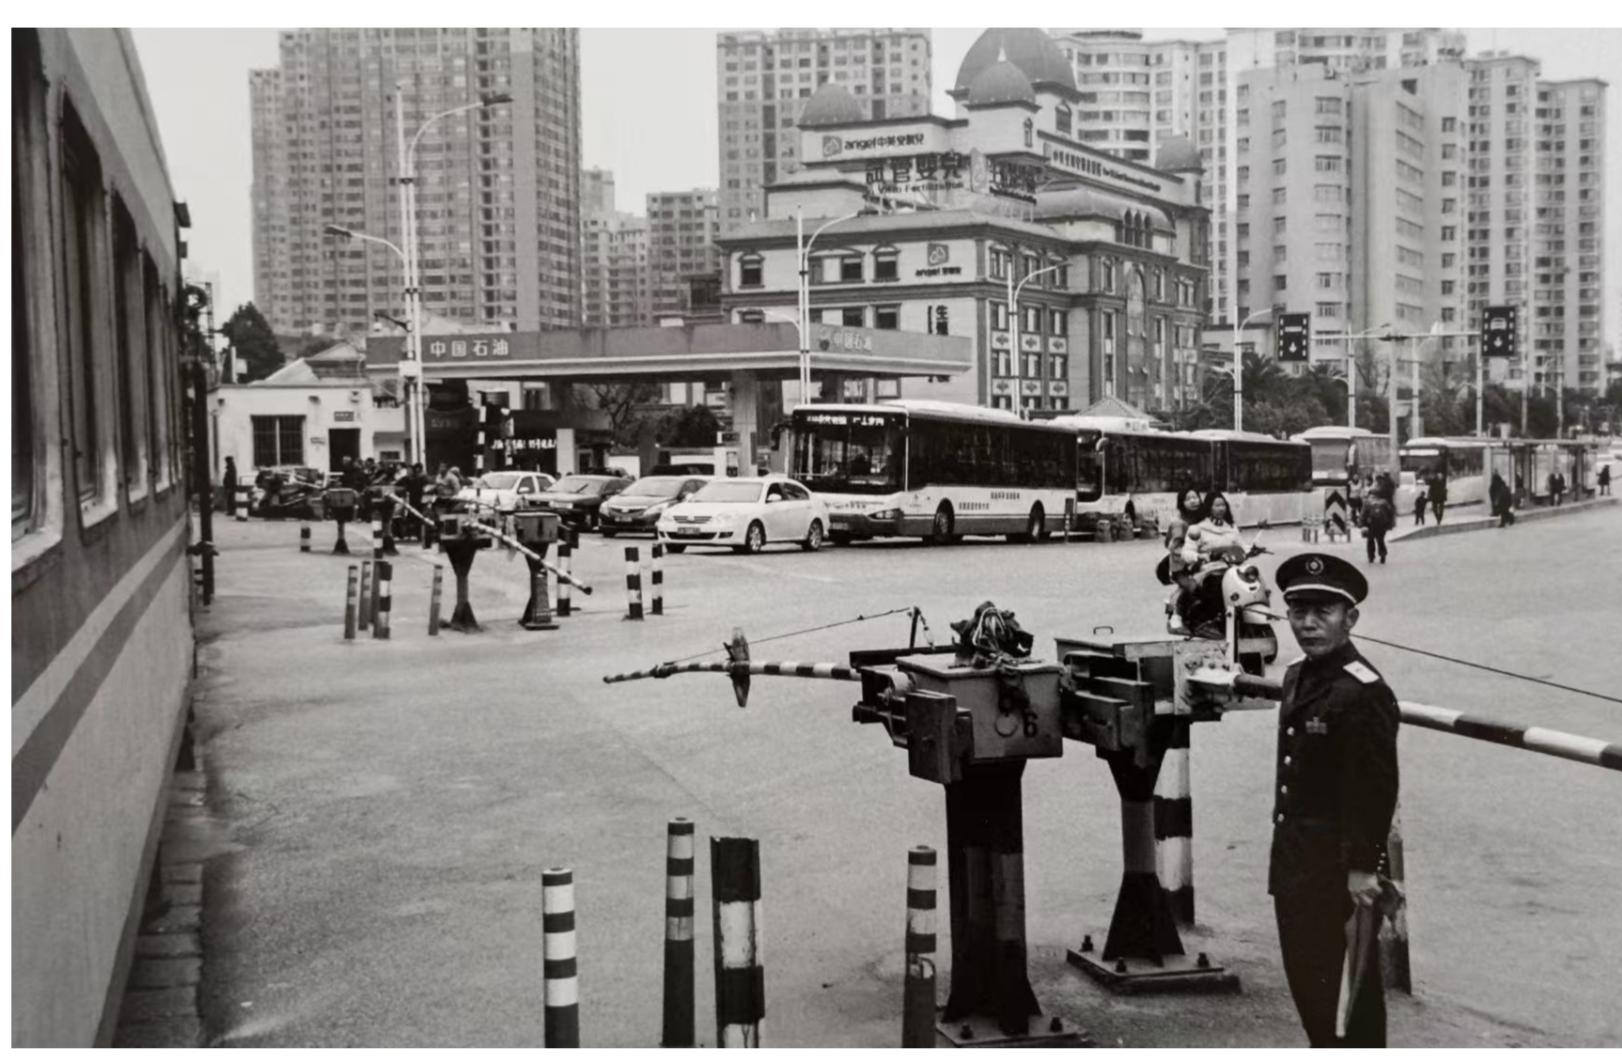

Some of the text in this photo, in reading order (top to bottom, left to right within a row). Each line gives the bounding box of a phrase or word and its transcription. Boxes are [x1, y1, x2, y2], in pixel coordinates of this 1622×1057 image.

[844, 138, 876, 150] angel
[430, 339, 509, 358] 中国石油
